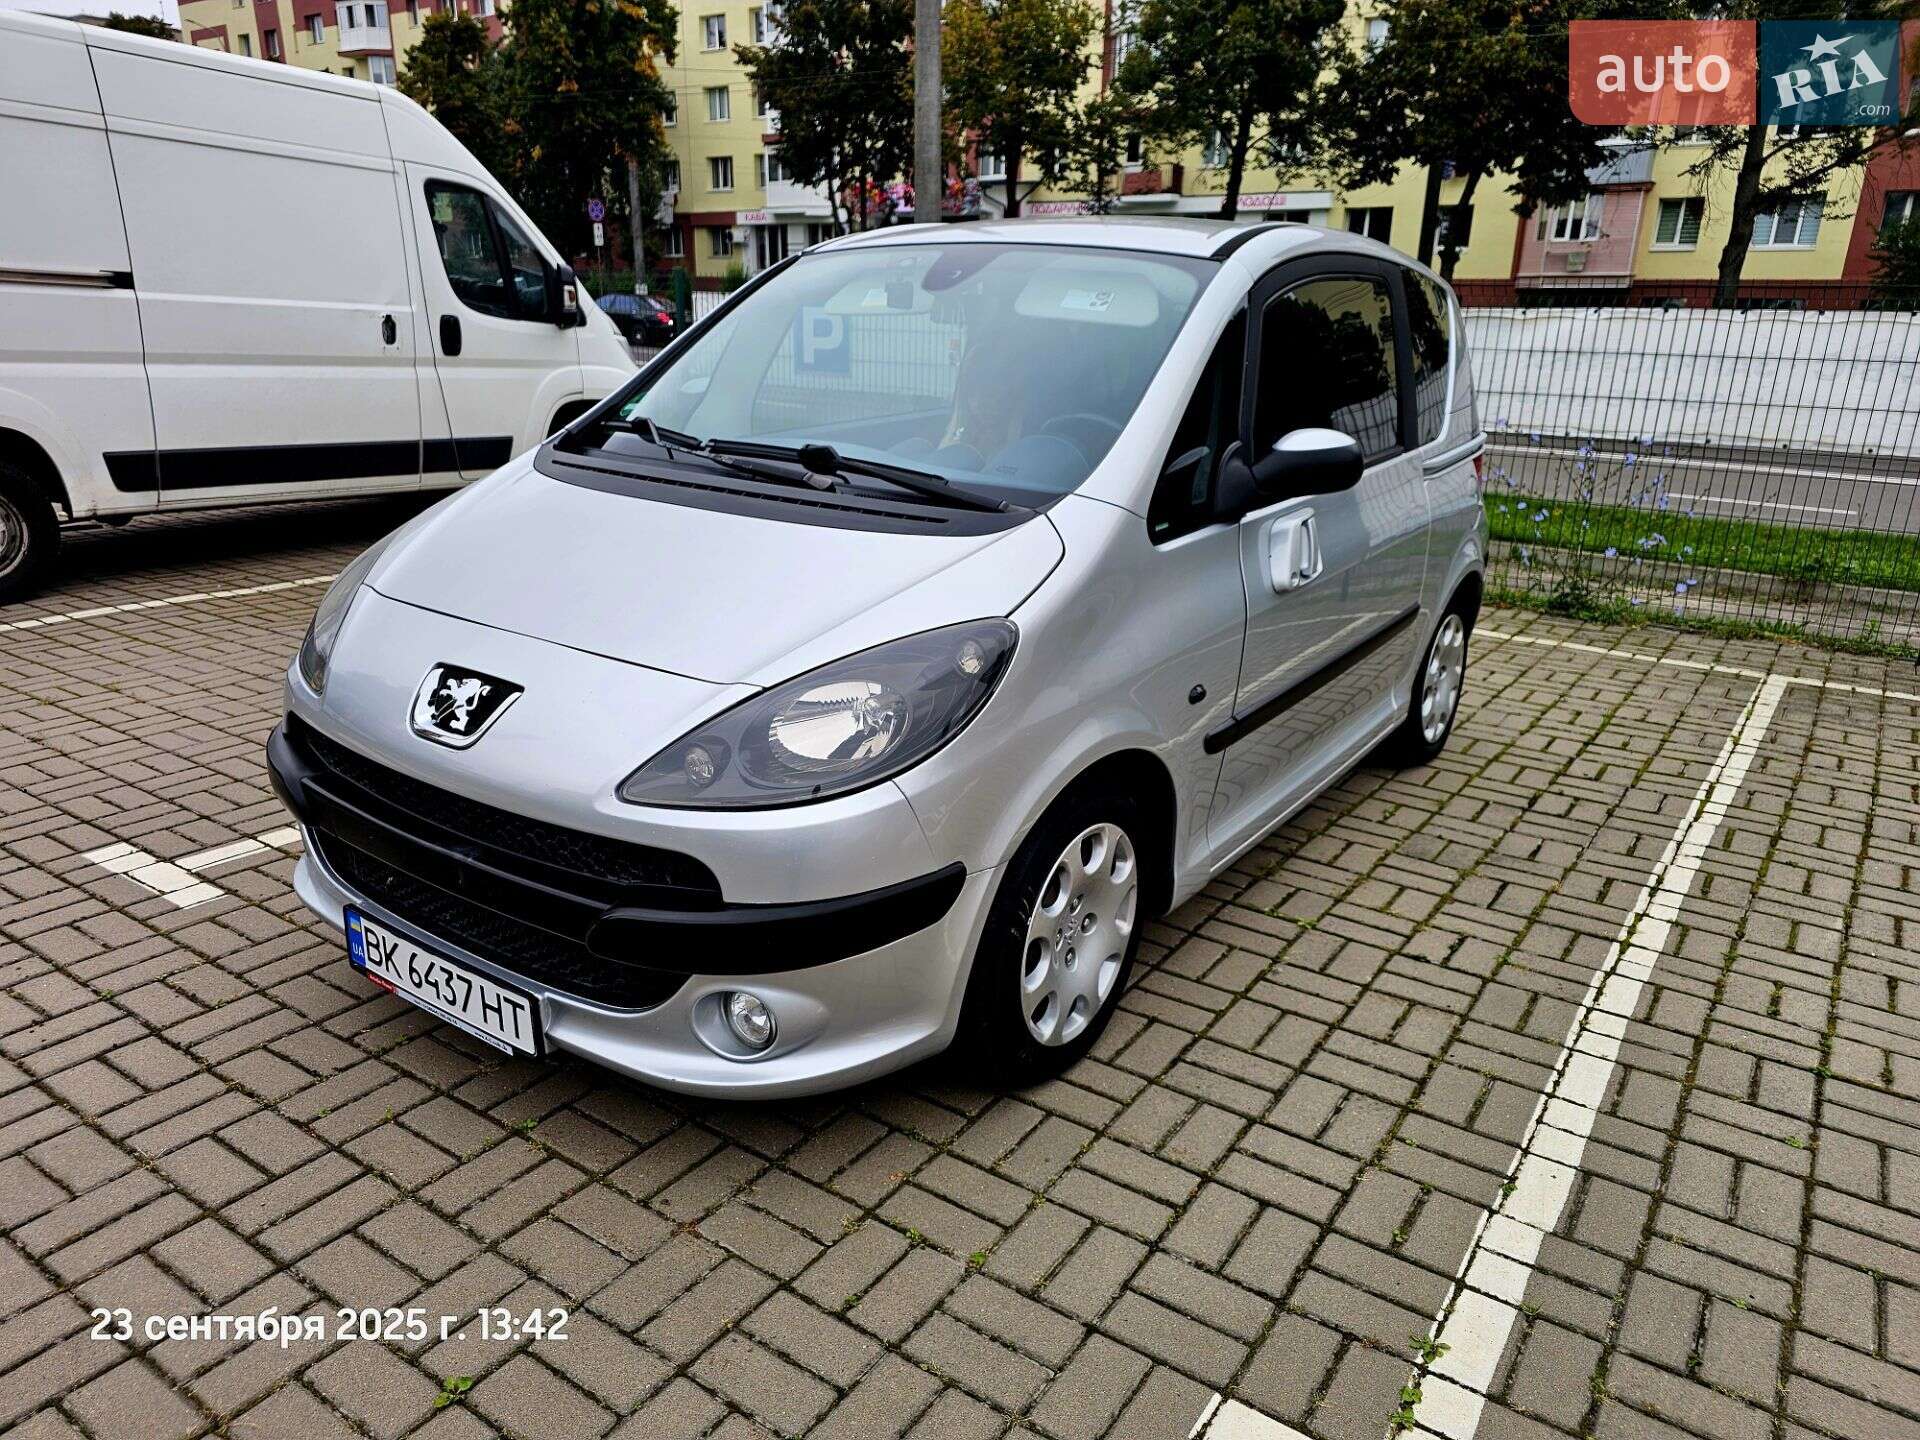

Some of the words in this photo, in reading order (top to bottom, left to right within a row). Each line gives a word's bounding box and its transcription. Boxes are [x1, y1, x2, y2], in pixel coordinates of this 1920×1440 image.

[802, 306, 844, 364] P
[352, 942, 365, 958] UA
[364, 925, 403, 981] BK
[408, 952, 473, 1013] 6437
[480, 984, 525, 1040] HT
